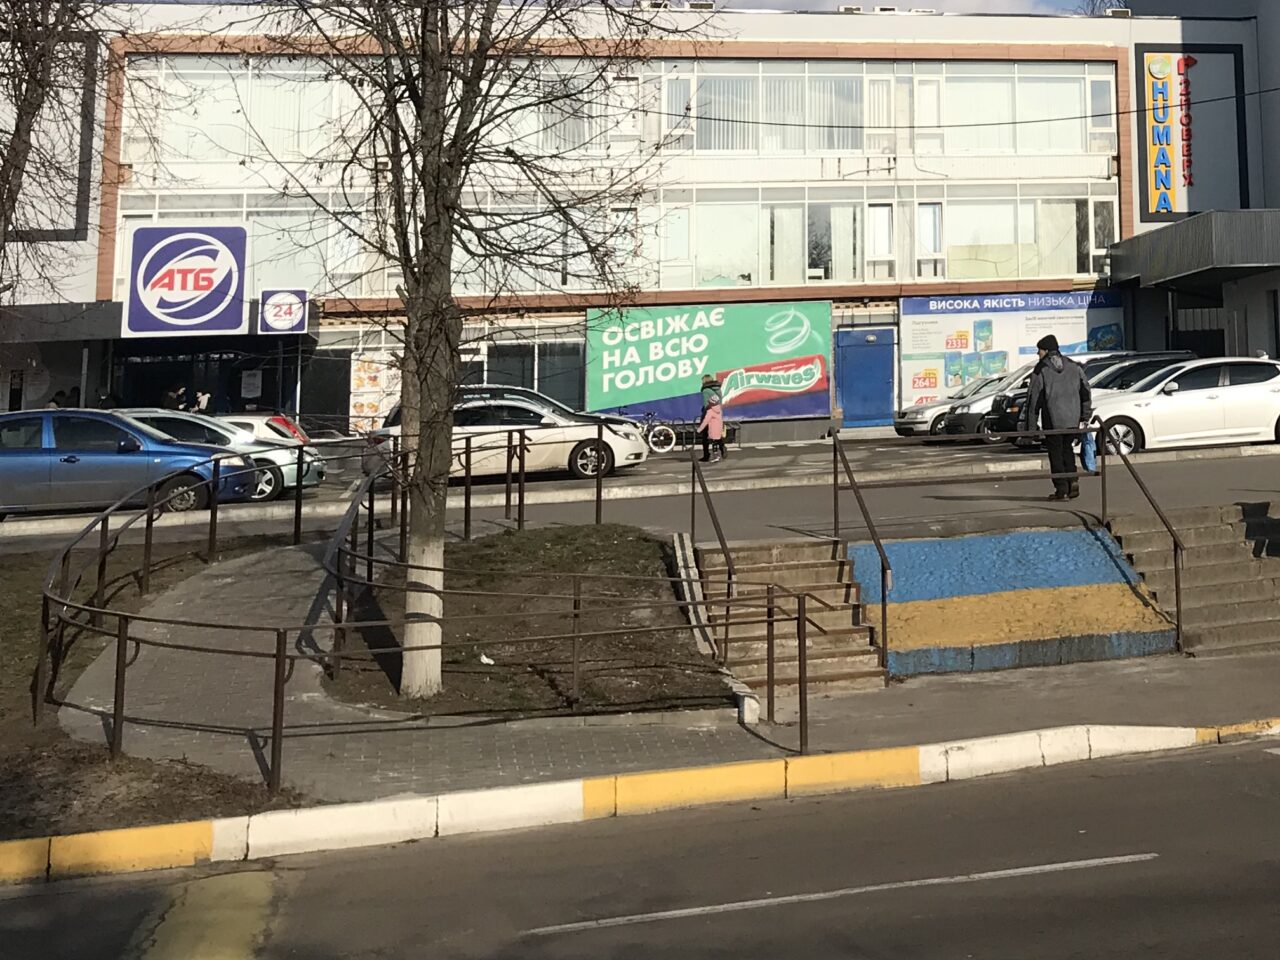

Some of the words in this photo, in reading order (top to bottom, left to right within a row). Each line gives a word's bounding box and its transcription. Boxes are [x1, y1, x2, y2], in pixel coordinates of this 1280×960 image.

[1151, 80, 1173, 213] HUMANA
[150, 268, 218, 292] АТБ
[272, 304, 293, 318] 24
[929, 300, 980, 310] ВИСОКА
[983, 298, 1026, 308] ЯКІСТЬ
[1028, 296, 1075, 307] НИЗЬКА
[1078, 294, 1106, 306] ЦІНА
[602, 307, 726, 347] ОСВІЖАЄ
[602, 346, 641, 370] НА
[649, 333, 709, 362] ВСЮ
[602, 355, 709, 393] ГОЛОВУ
[722, 362, 821, 401] Airwaves
